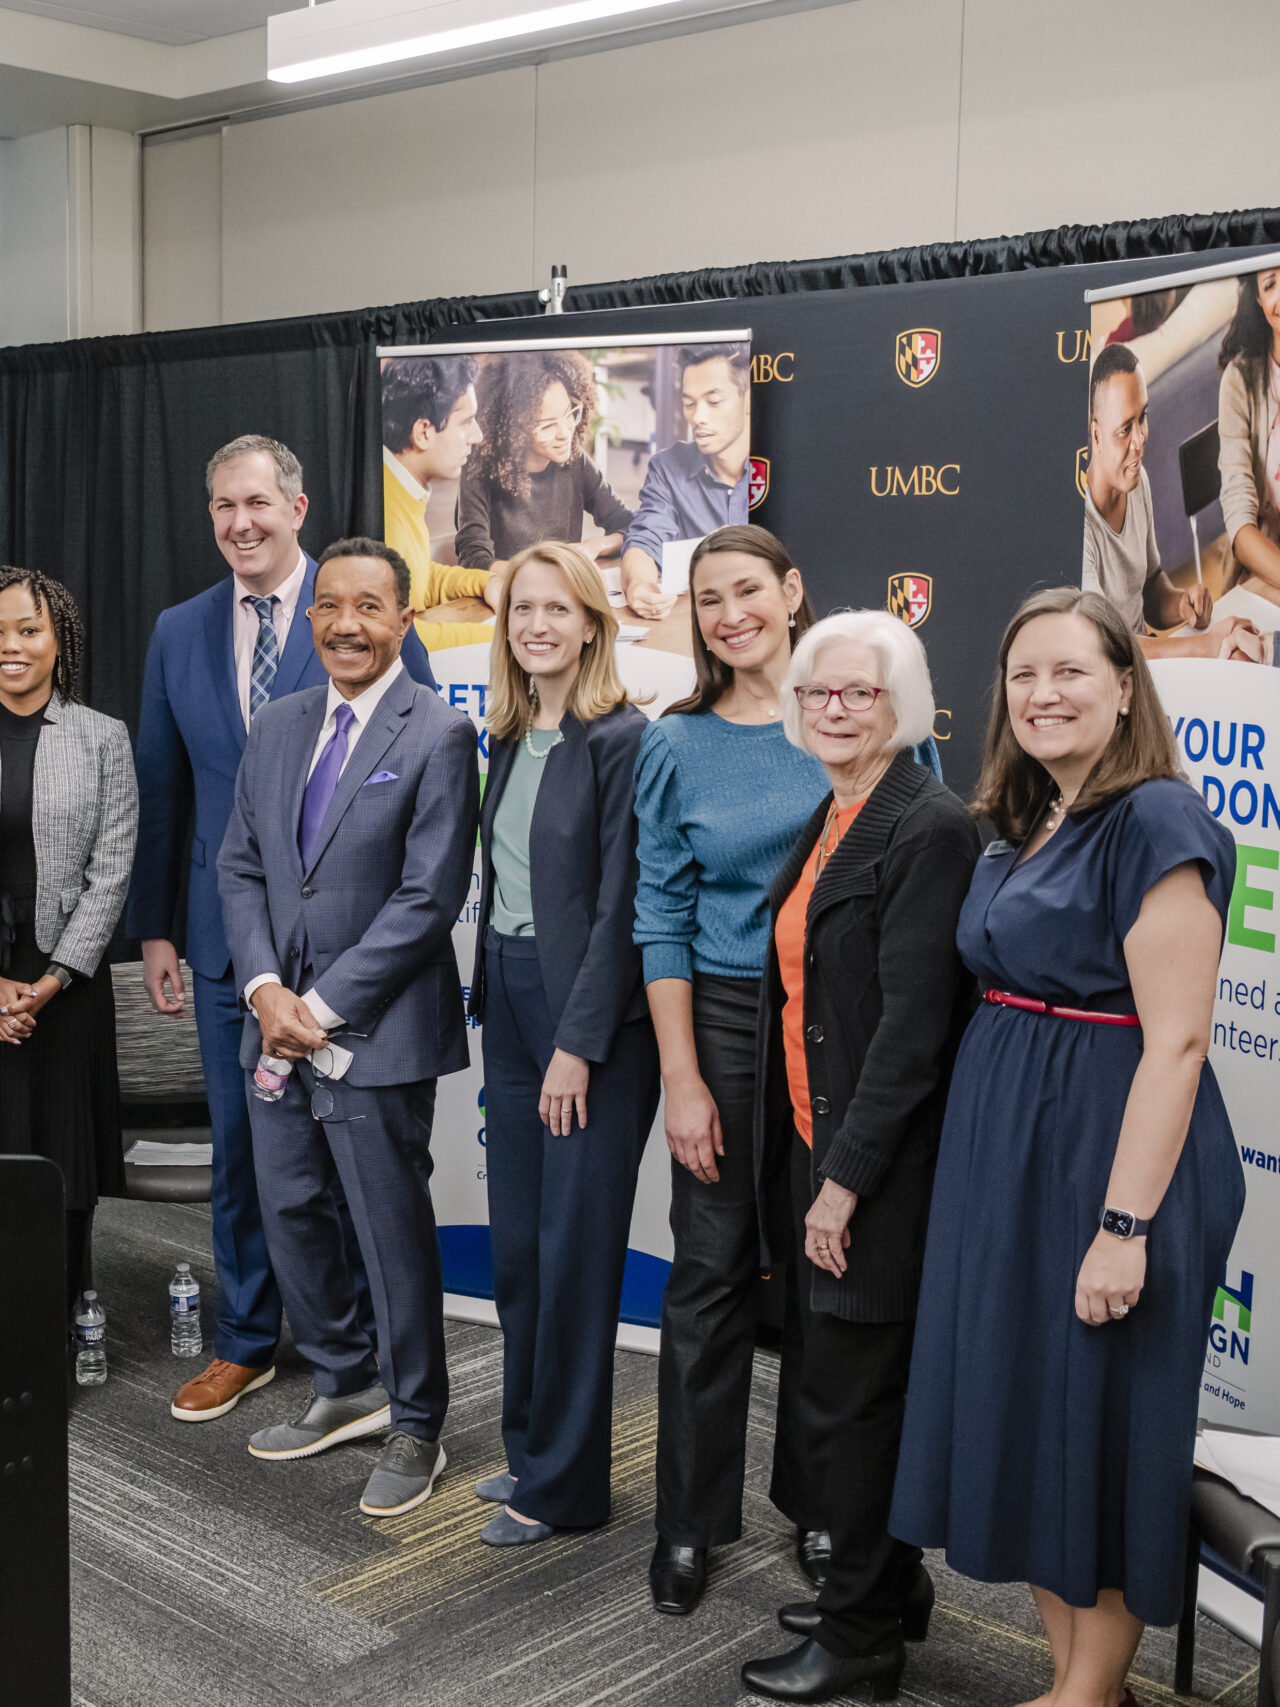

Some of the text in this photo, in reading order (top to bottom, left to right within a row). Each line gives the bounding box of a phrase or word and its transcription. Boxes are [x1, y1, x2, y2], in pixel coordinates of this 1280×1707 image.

[749, 353, 794, 383] BC
[870, 464, 960, 496] UMBC
[437, 684, 490, 717] ET
[1173, 716, 1265, 770] OUR
[1220, 978, 1266, 1010] ned
[1214, 1021, 1280, 1061] nteer
[1241, 1145, 1280, 1174] wan
[1204, 1382, 1221, 1397] and
[1222, 1391, 1246, 1410] Hope
